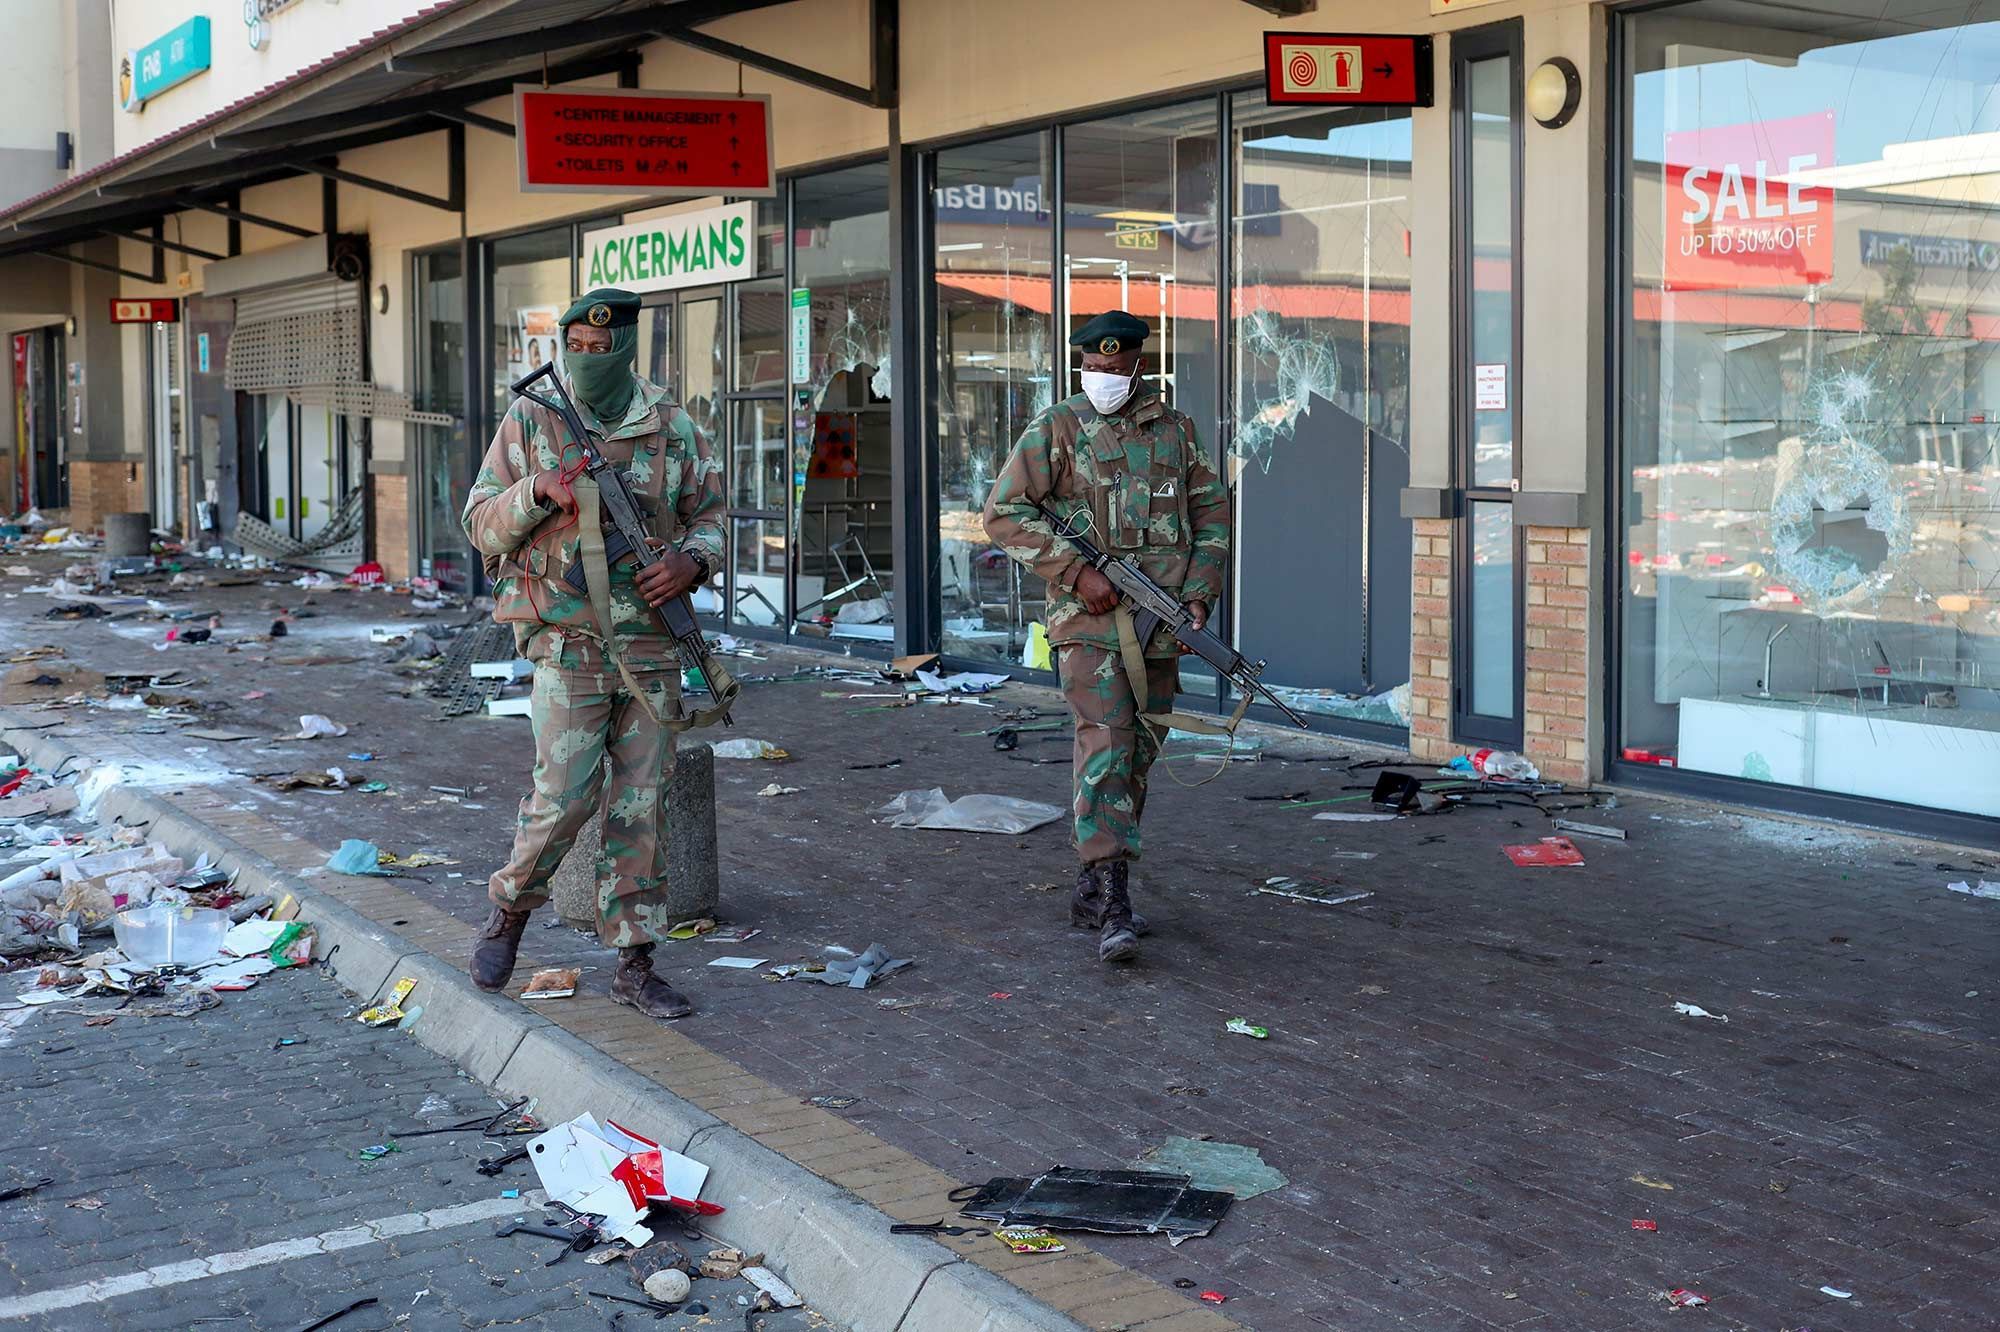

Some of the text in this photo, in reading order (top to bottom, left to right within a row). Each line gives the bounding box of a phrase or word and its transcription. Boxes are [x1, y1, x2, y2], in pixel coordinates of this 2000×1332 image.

[562, 108, 721, 125] CENTRE MANAGEMENT
[564, 133, 688, 148] SECURITY OFFICE
[565, 158, 624, 172] TOILETS
[1682, 153, 1818, 225] SALE
[588, 216, 745, 287] ACKERMANS
[1680, 224, 1818, 257] UP TO 50% OFF
